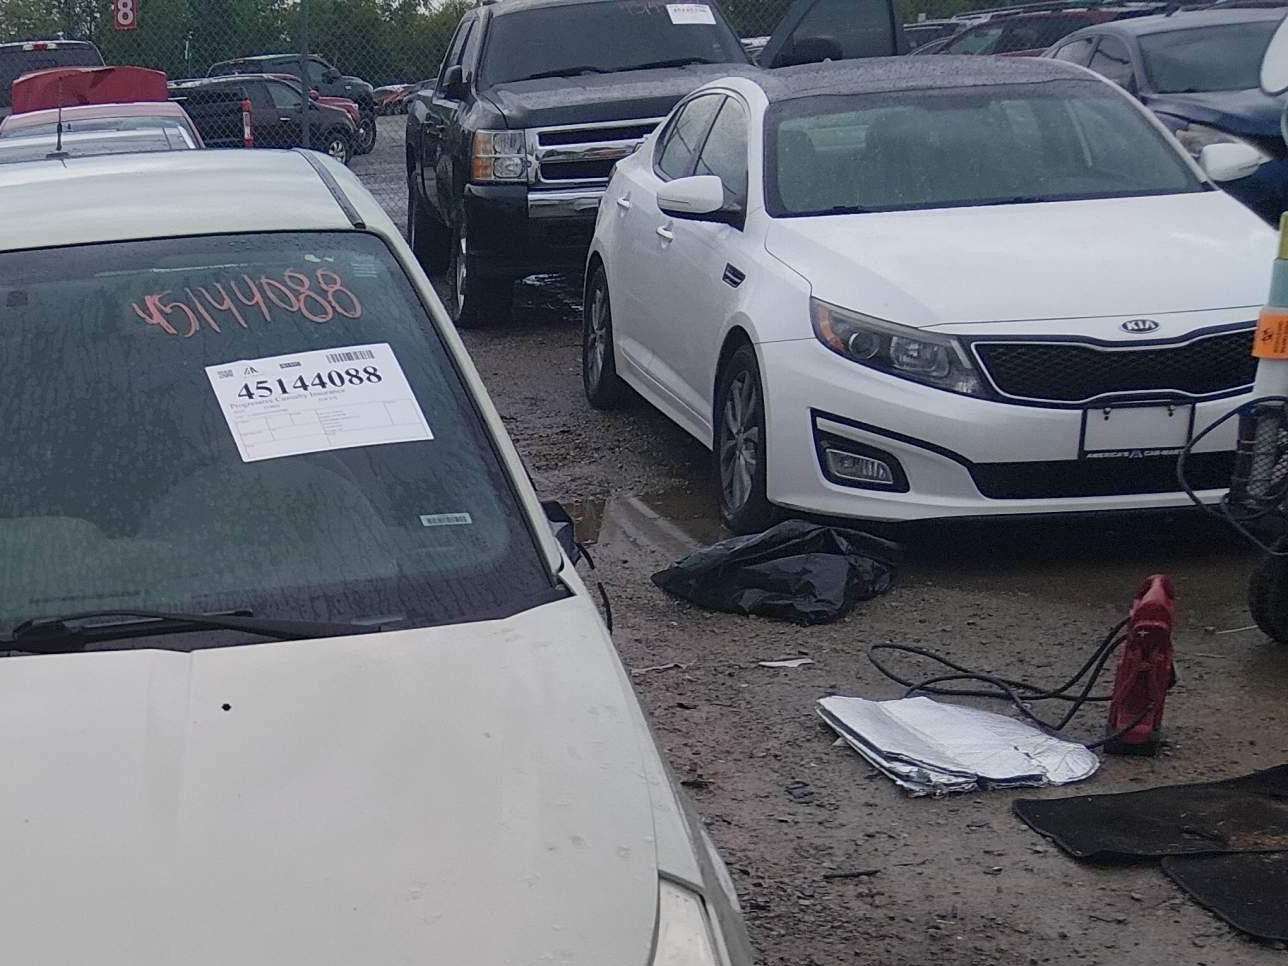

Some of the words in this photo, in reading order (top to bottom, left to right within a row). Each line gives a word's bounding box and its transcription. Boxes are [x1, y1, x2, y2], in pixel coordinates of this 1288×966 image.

[117, 0, 134, 25] 8
[132, 267, 362, 337] 45144088
[237, 365, 383, 400] 45144088
